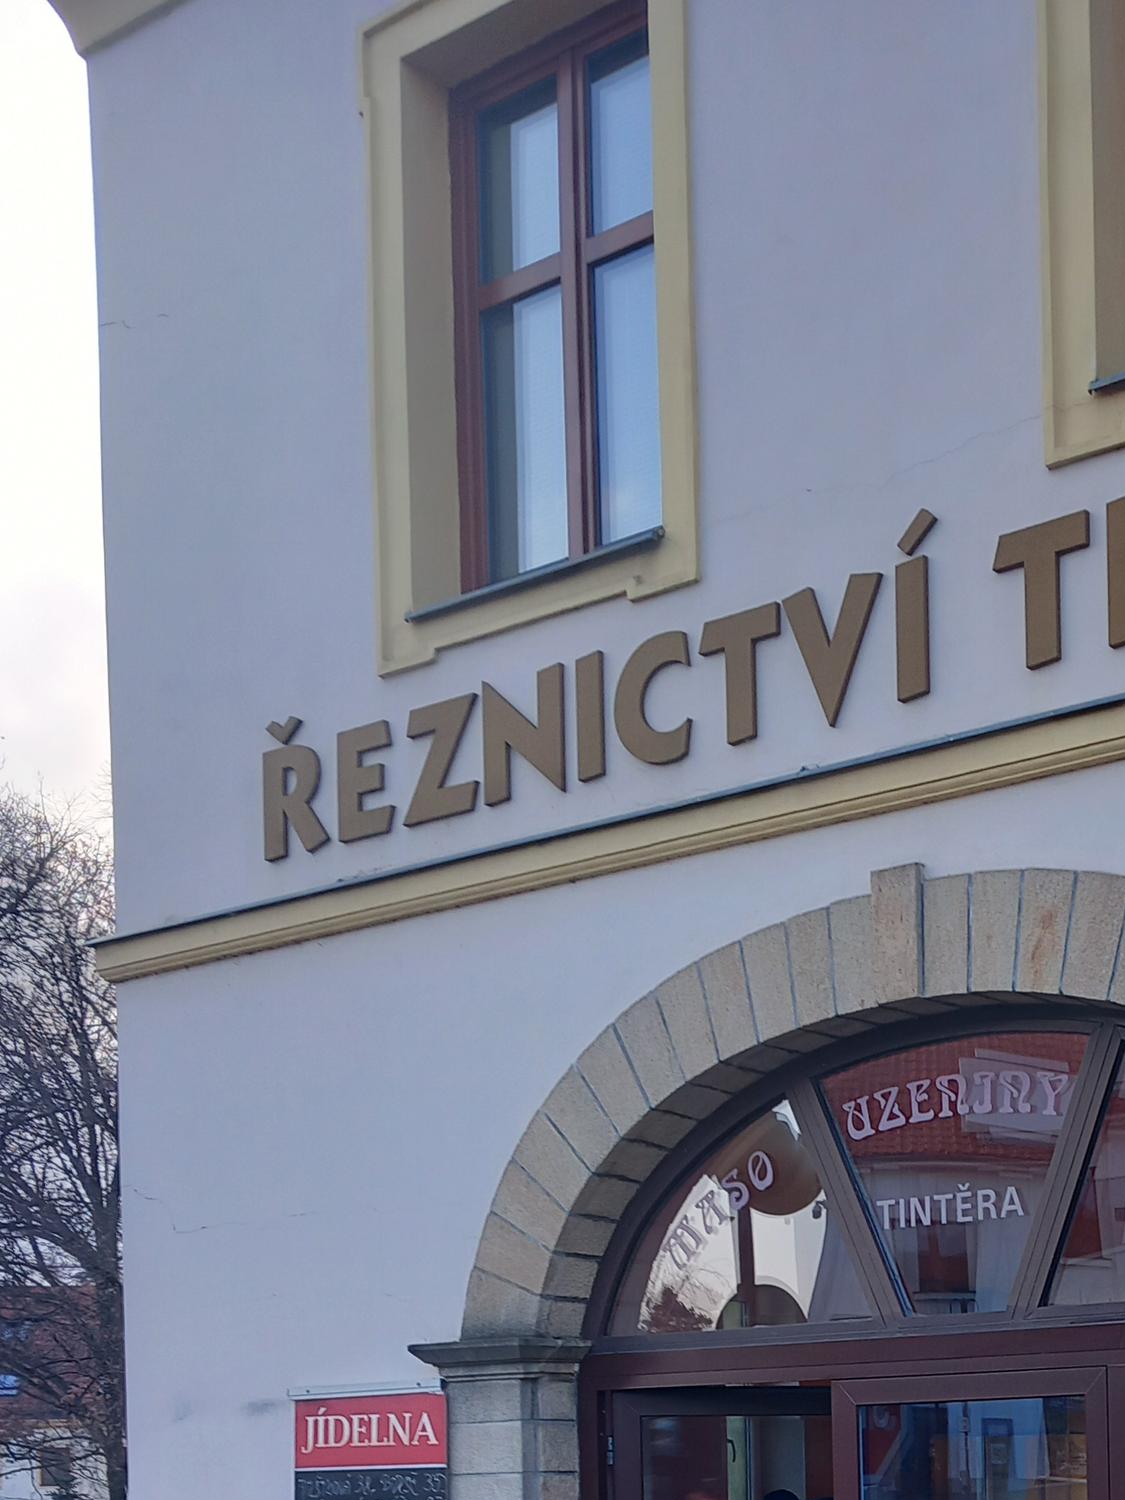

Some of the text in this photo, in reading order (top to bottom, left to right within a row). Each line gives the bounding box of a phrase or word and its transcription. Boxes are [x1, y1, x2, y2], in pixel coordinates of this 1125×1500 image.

[262, 508, 938, 862] ŘEZNICTVÍ
[841, 1069, 1070, 1141] UZENINY
[876, 1181, 1026, 1232] TINTĚRA
[300, 1406, 439, 1454] JÍDELNA
